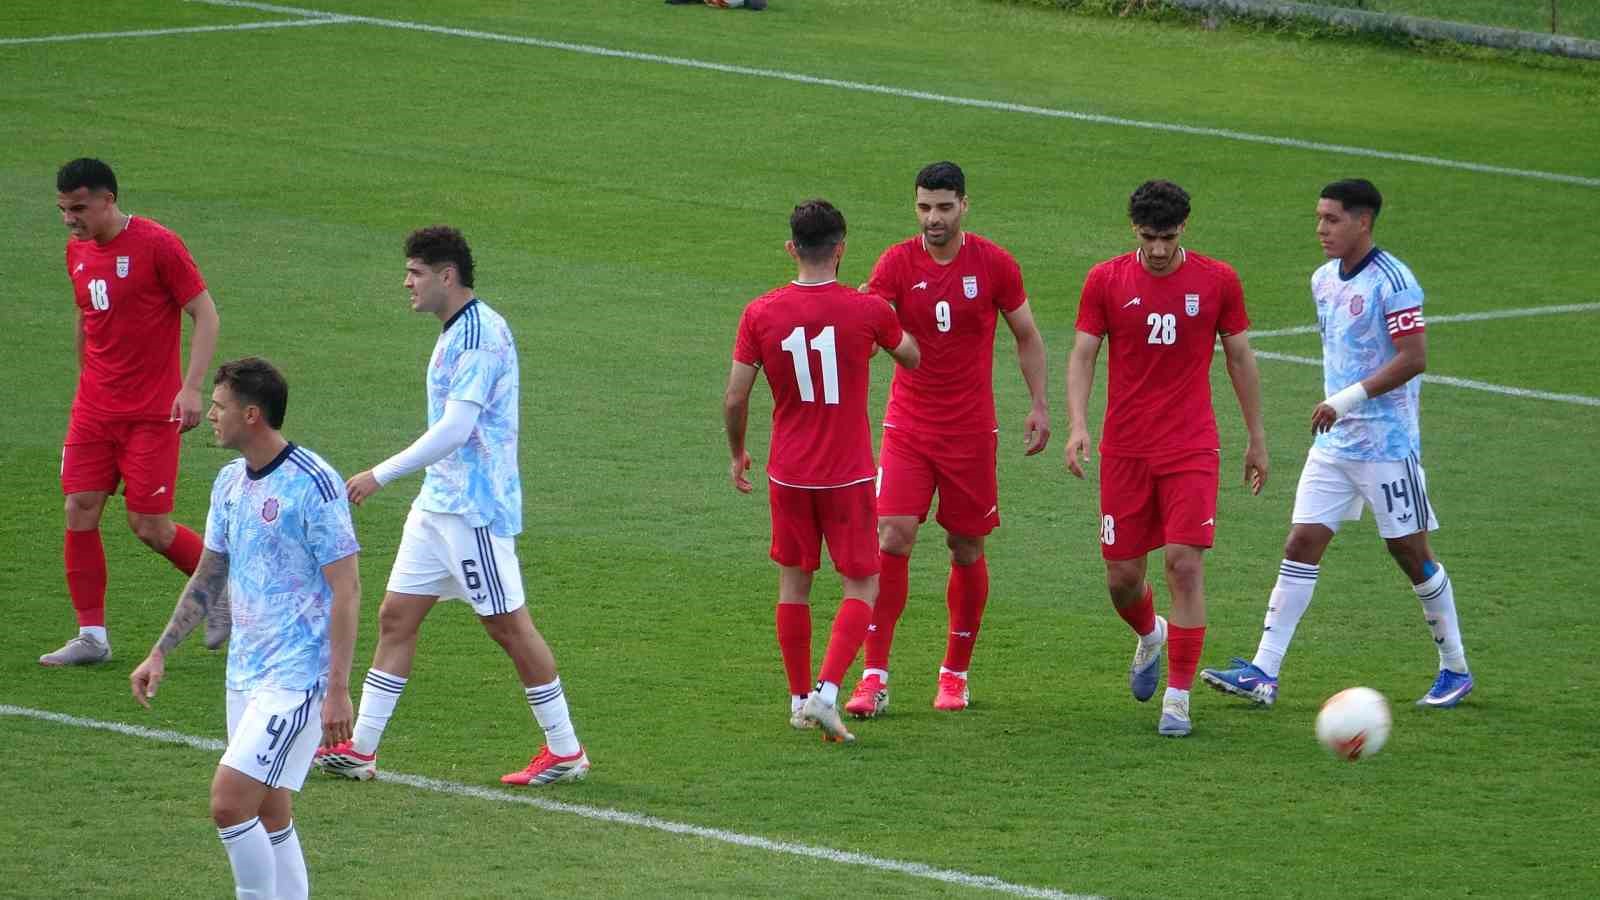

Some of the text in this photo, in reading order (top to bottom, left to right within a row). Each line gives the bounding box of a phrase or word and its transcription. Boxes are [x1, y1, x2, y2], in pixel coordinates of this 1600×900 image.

[88, 279, 109, 311] 18
[935, 300, 951, 333] 9
[1147, 313, 1177, 346] 28
[780, 325, 841, 405] 11
[1381, 478, 1410, 513] 14
[461, 559, 482, 590] 6
[266, 715, 287, 751] 4
